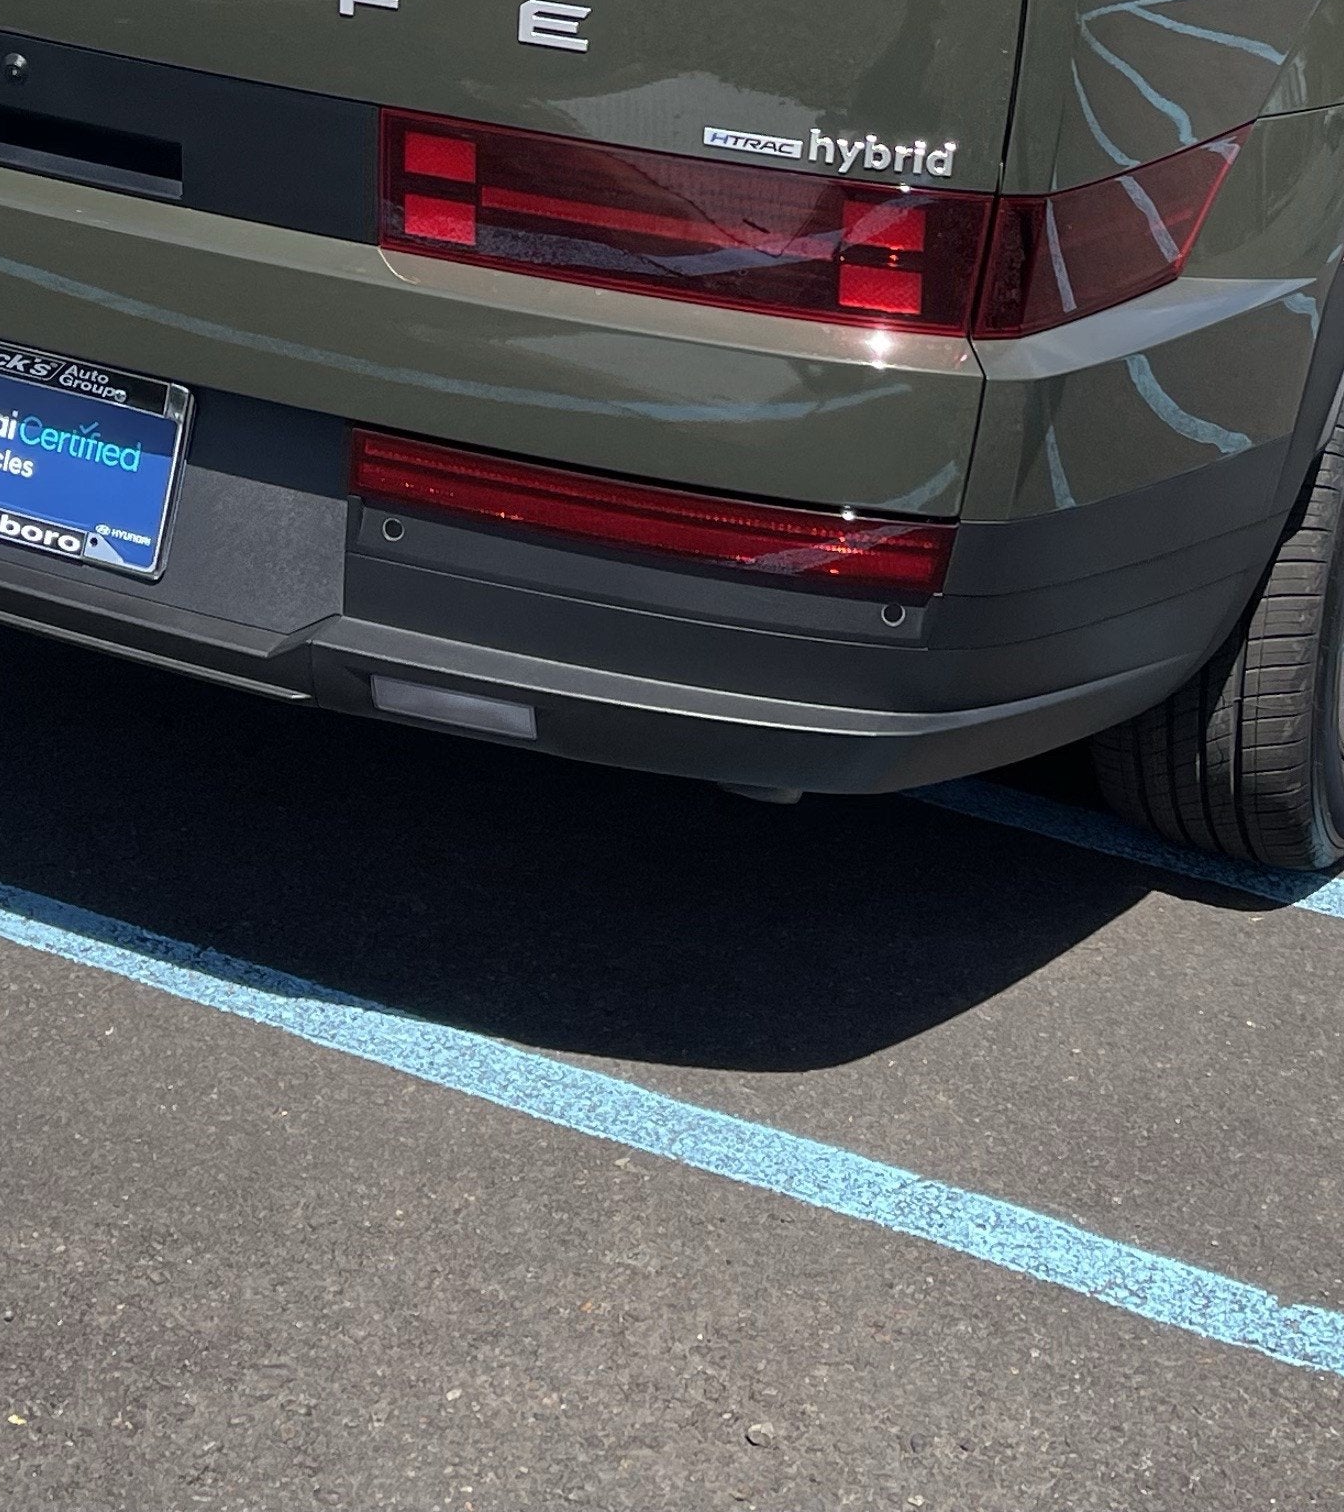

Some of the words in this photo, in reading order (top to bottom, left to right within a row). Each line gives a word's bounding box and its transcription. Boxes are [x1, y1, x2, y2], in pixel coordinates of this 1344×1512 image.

[709, 131, 795, 156] HTRAC
[807, 127, 957, 178] hybrid
[64, 364, 109, 385] Auto
